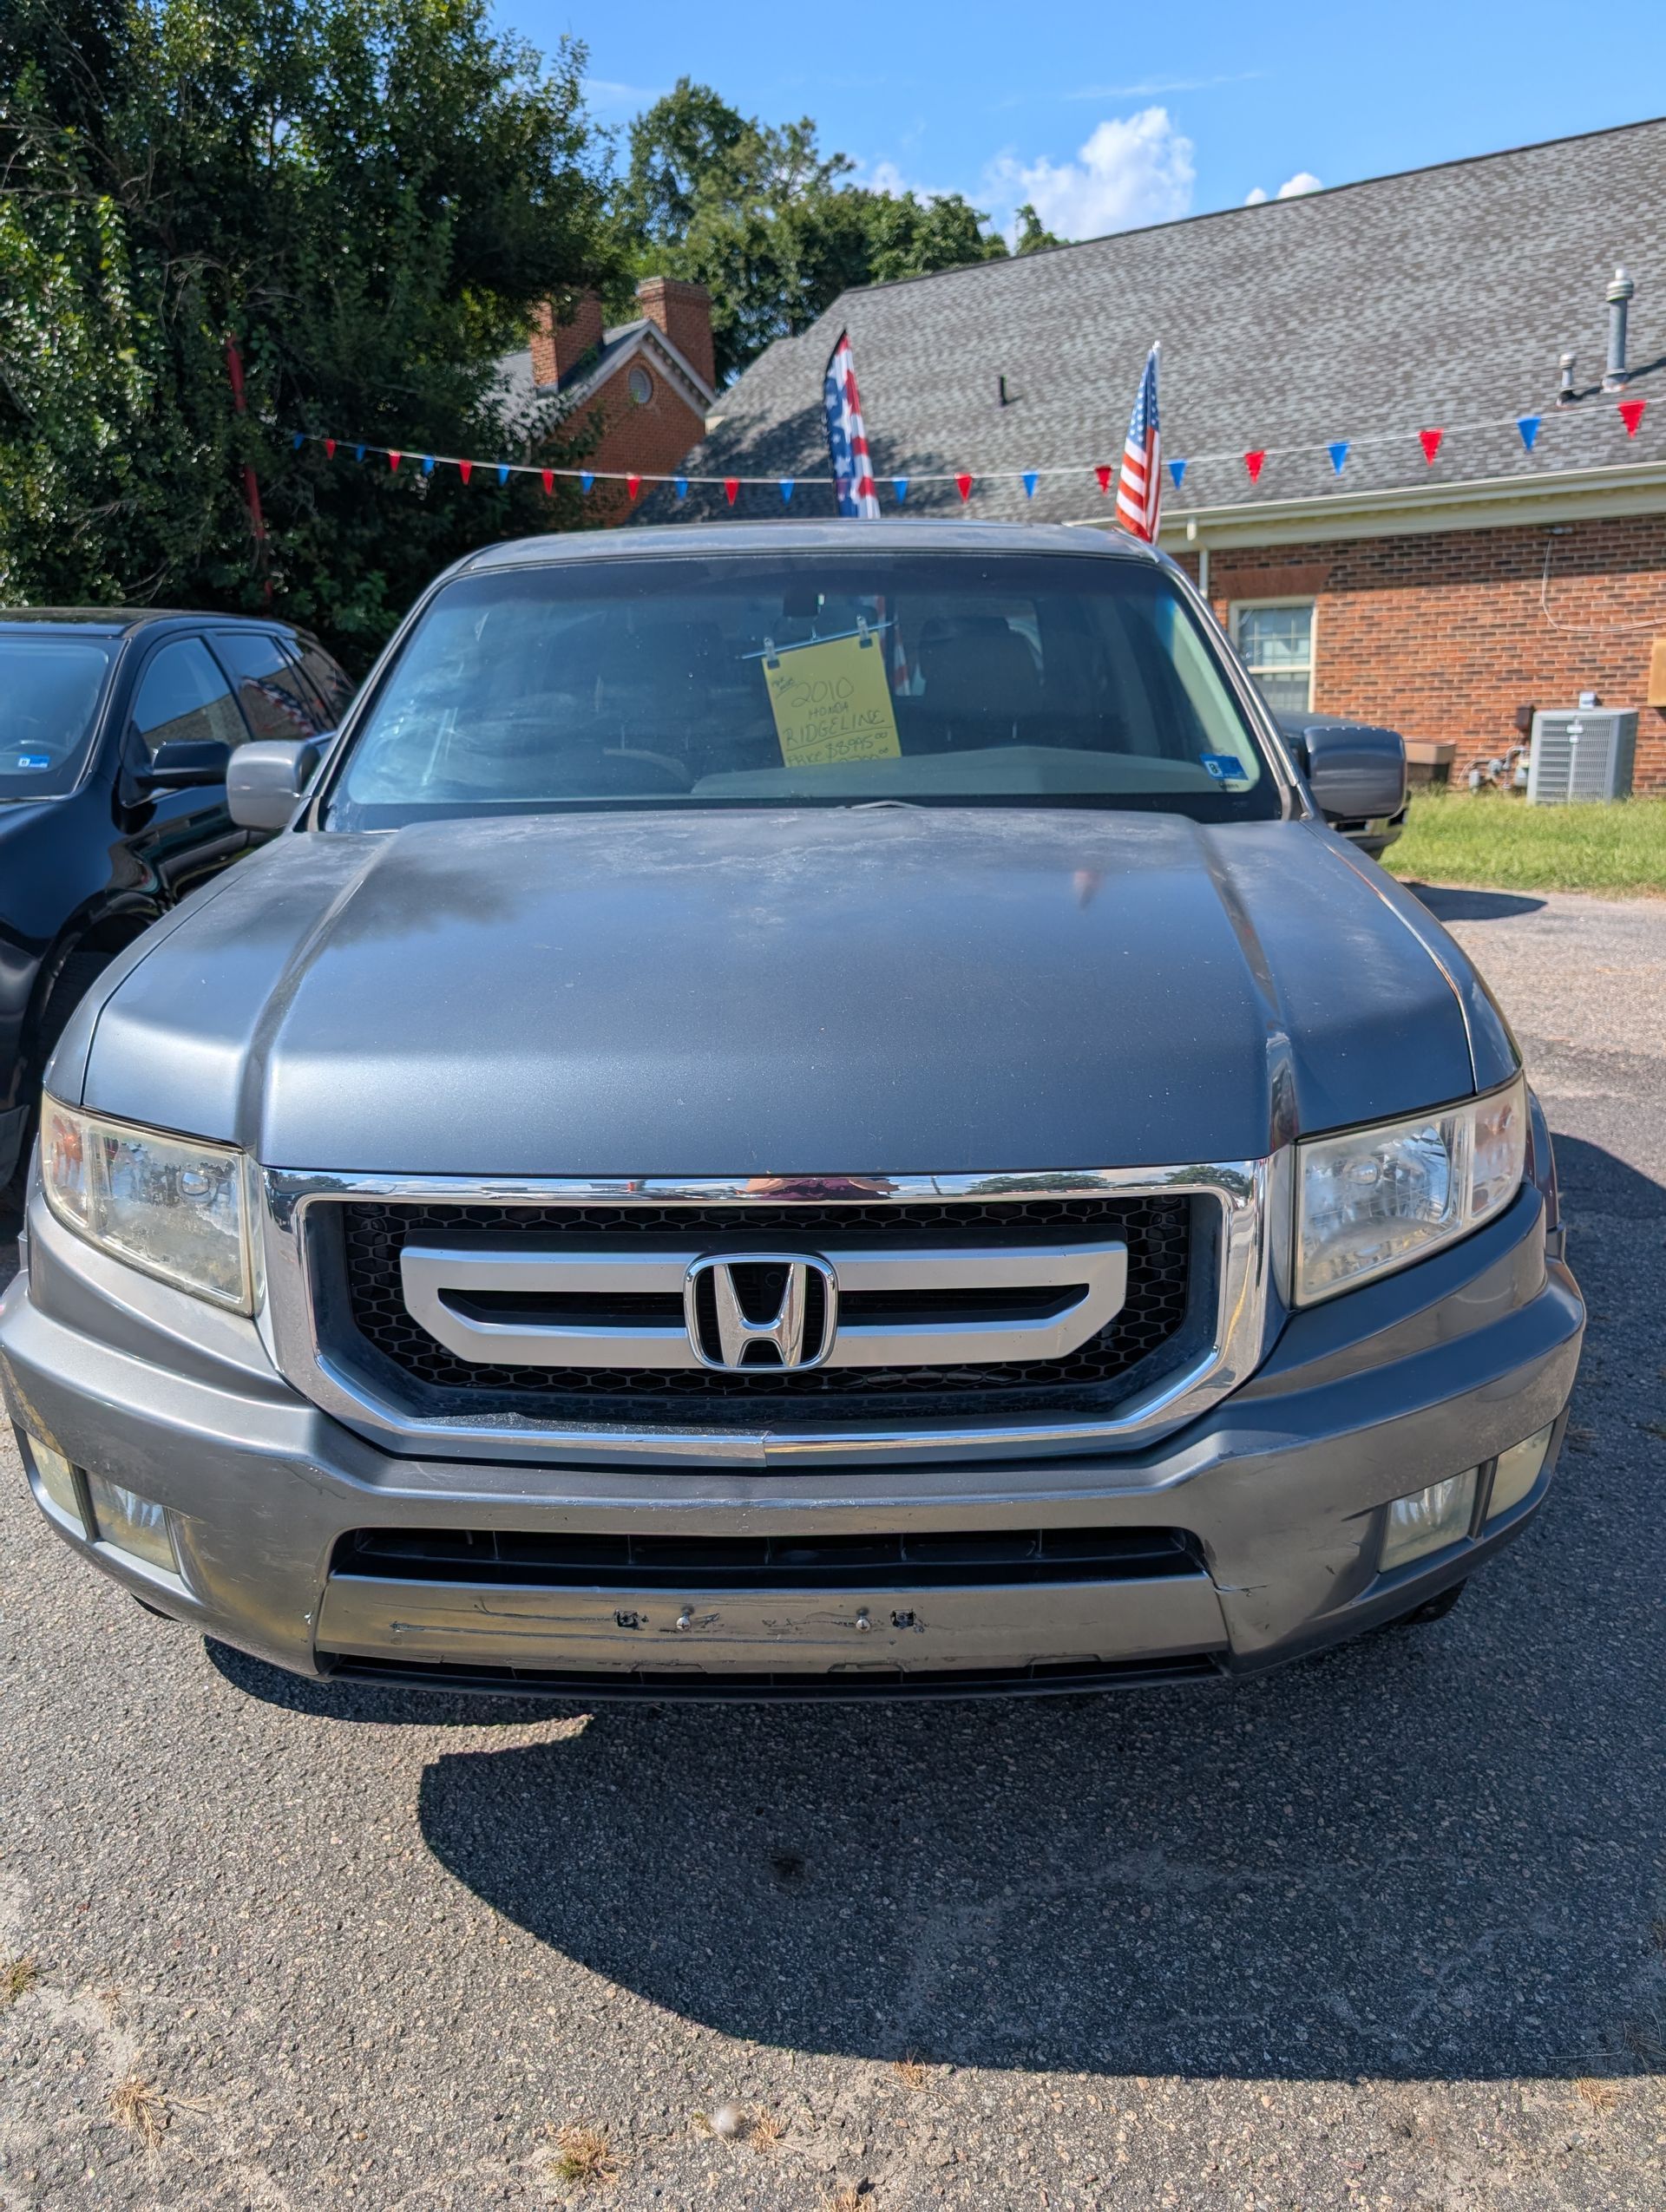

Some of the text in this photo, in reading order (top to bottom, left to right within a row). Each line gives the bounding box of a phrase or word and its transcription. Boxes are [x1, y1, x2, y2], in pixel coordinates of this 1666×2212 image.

[790, 677, 855, 708] 2010
[808, 702, 849, 721] HONDA
[783, 710, 885, 747] RIDGELINE
